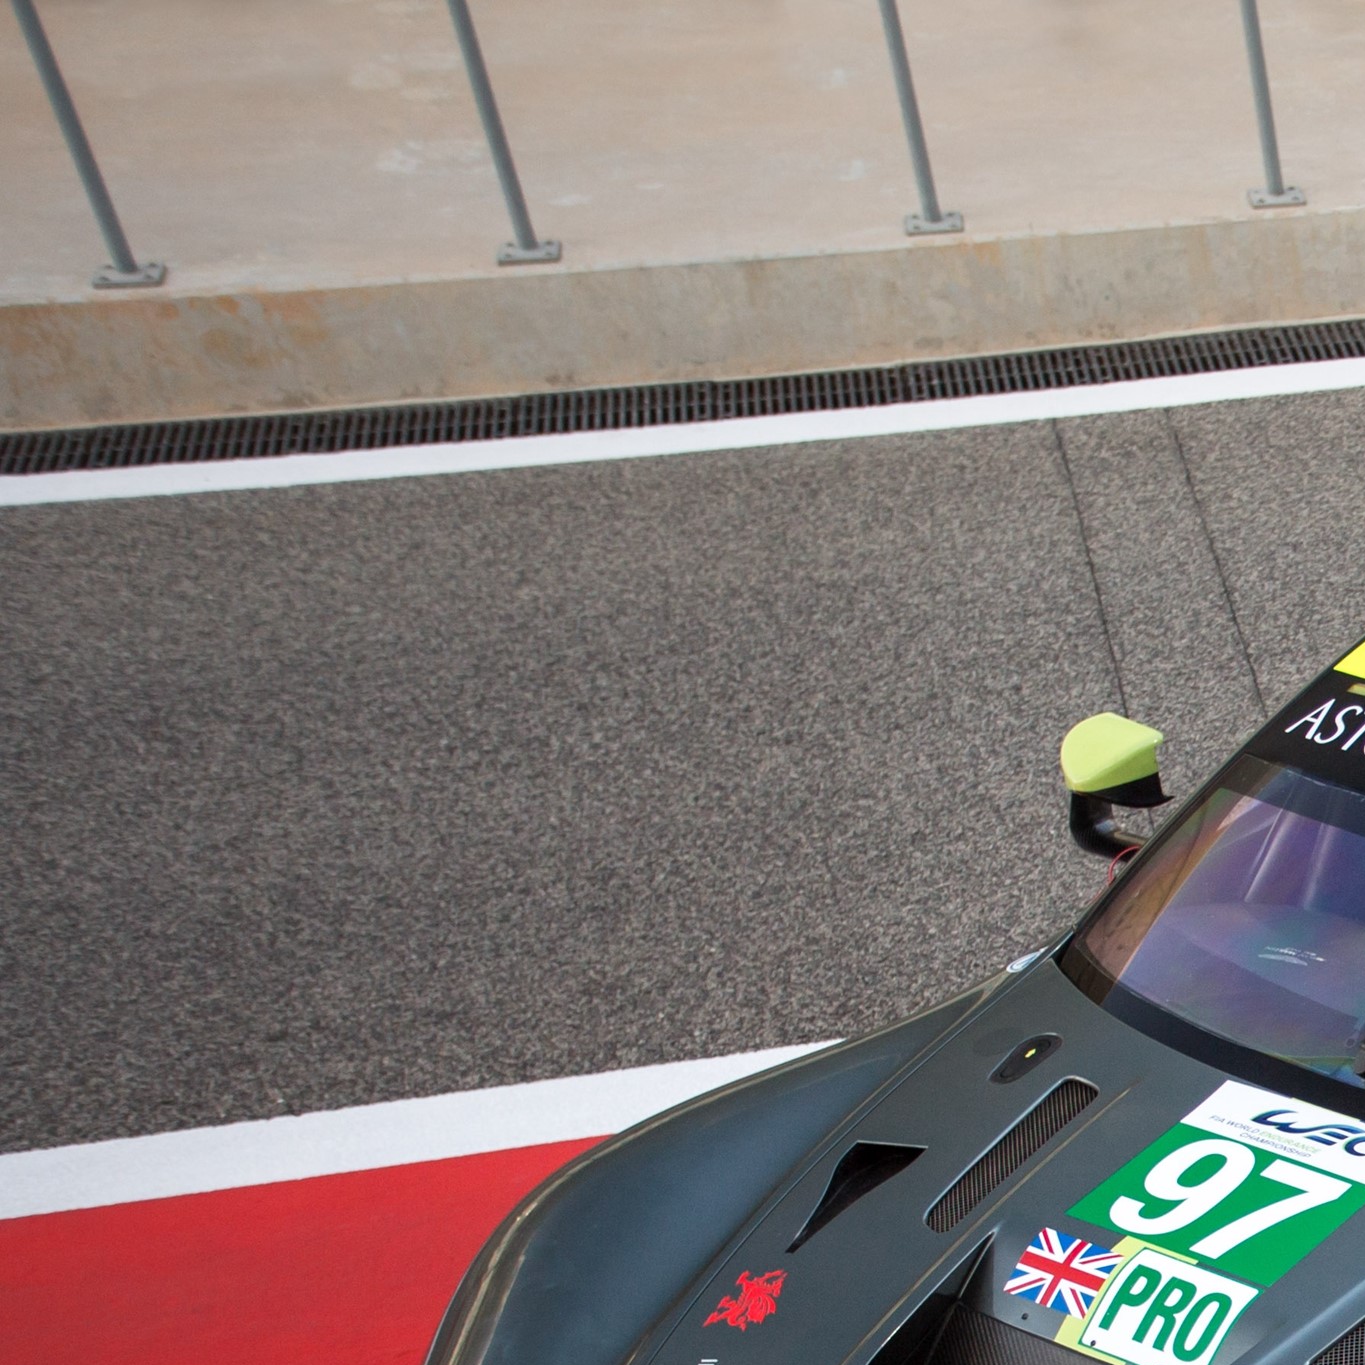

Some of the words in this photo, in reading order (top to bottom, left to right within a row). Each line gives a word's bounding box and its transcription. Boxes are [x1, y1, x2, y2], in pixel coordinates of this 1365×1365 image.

[1208, 1114, 1227, 1124] FIA
[1227, 1119, 1260, 1134] WORLD
[1259, 1131, 1322, 1154] ENDURANCE
[1239, 1132, 1312, 1159] CHAMPIONSHIP
[1109, 1138, 1353, 1260] 97
[1098, 1263, 1233, 1362] PRO
